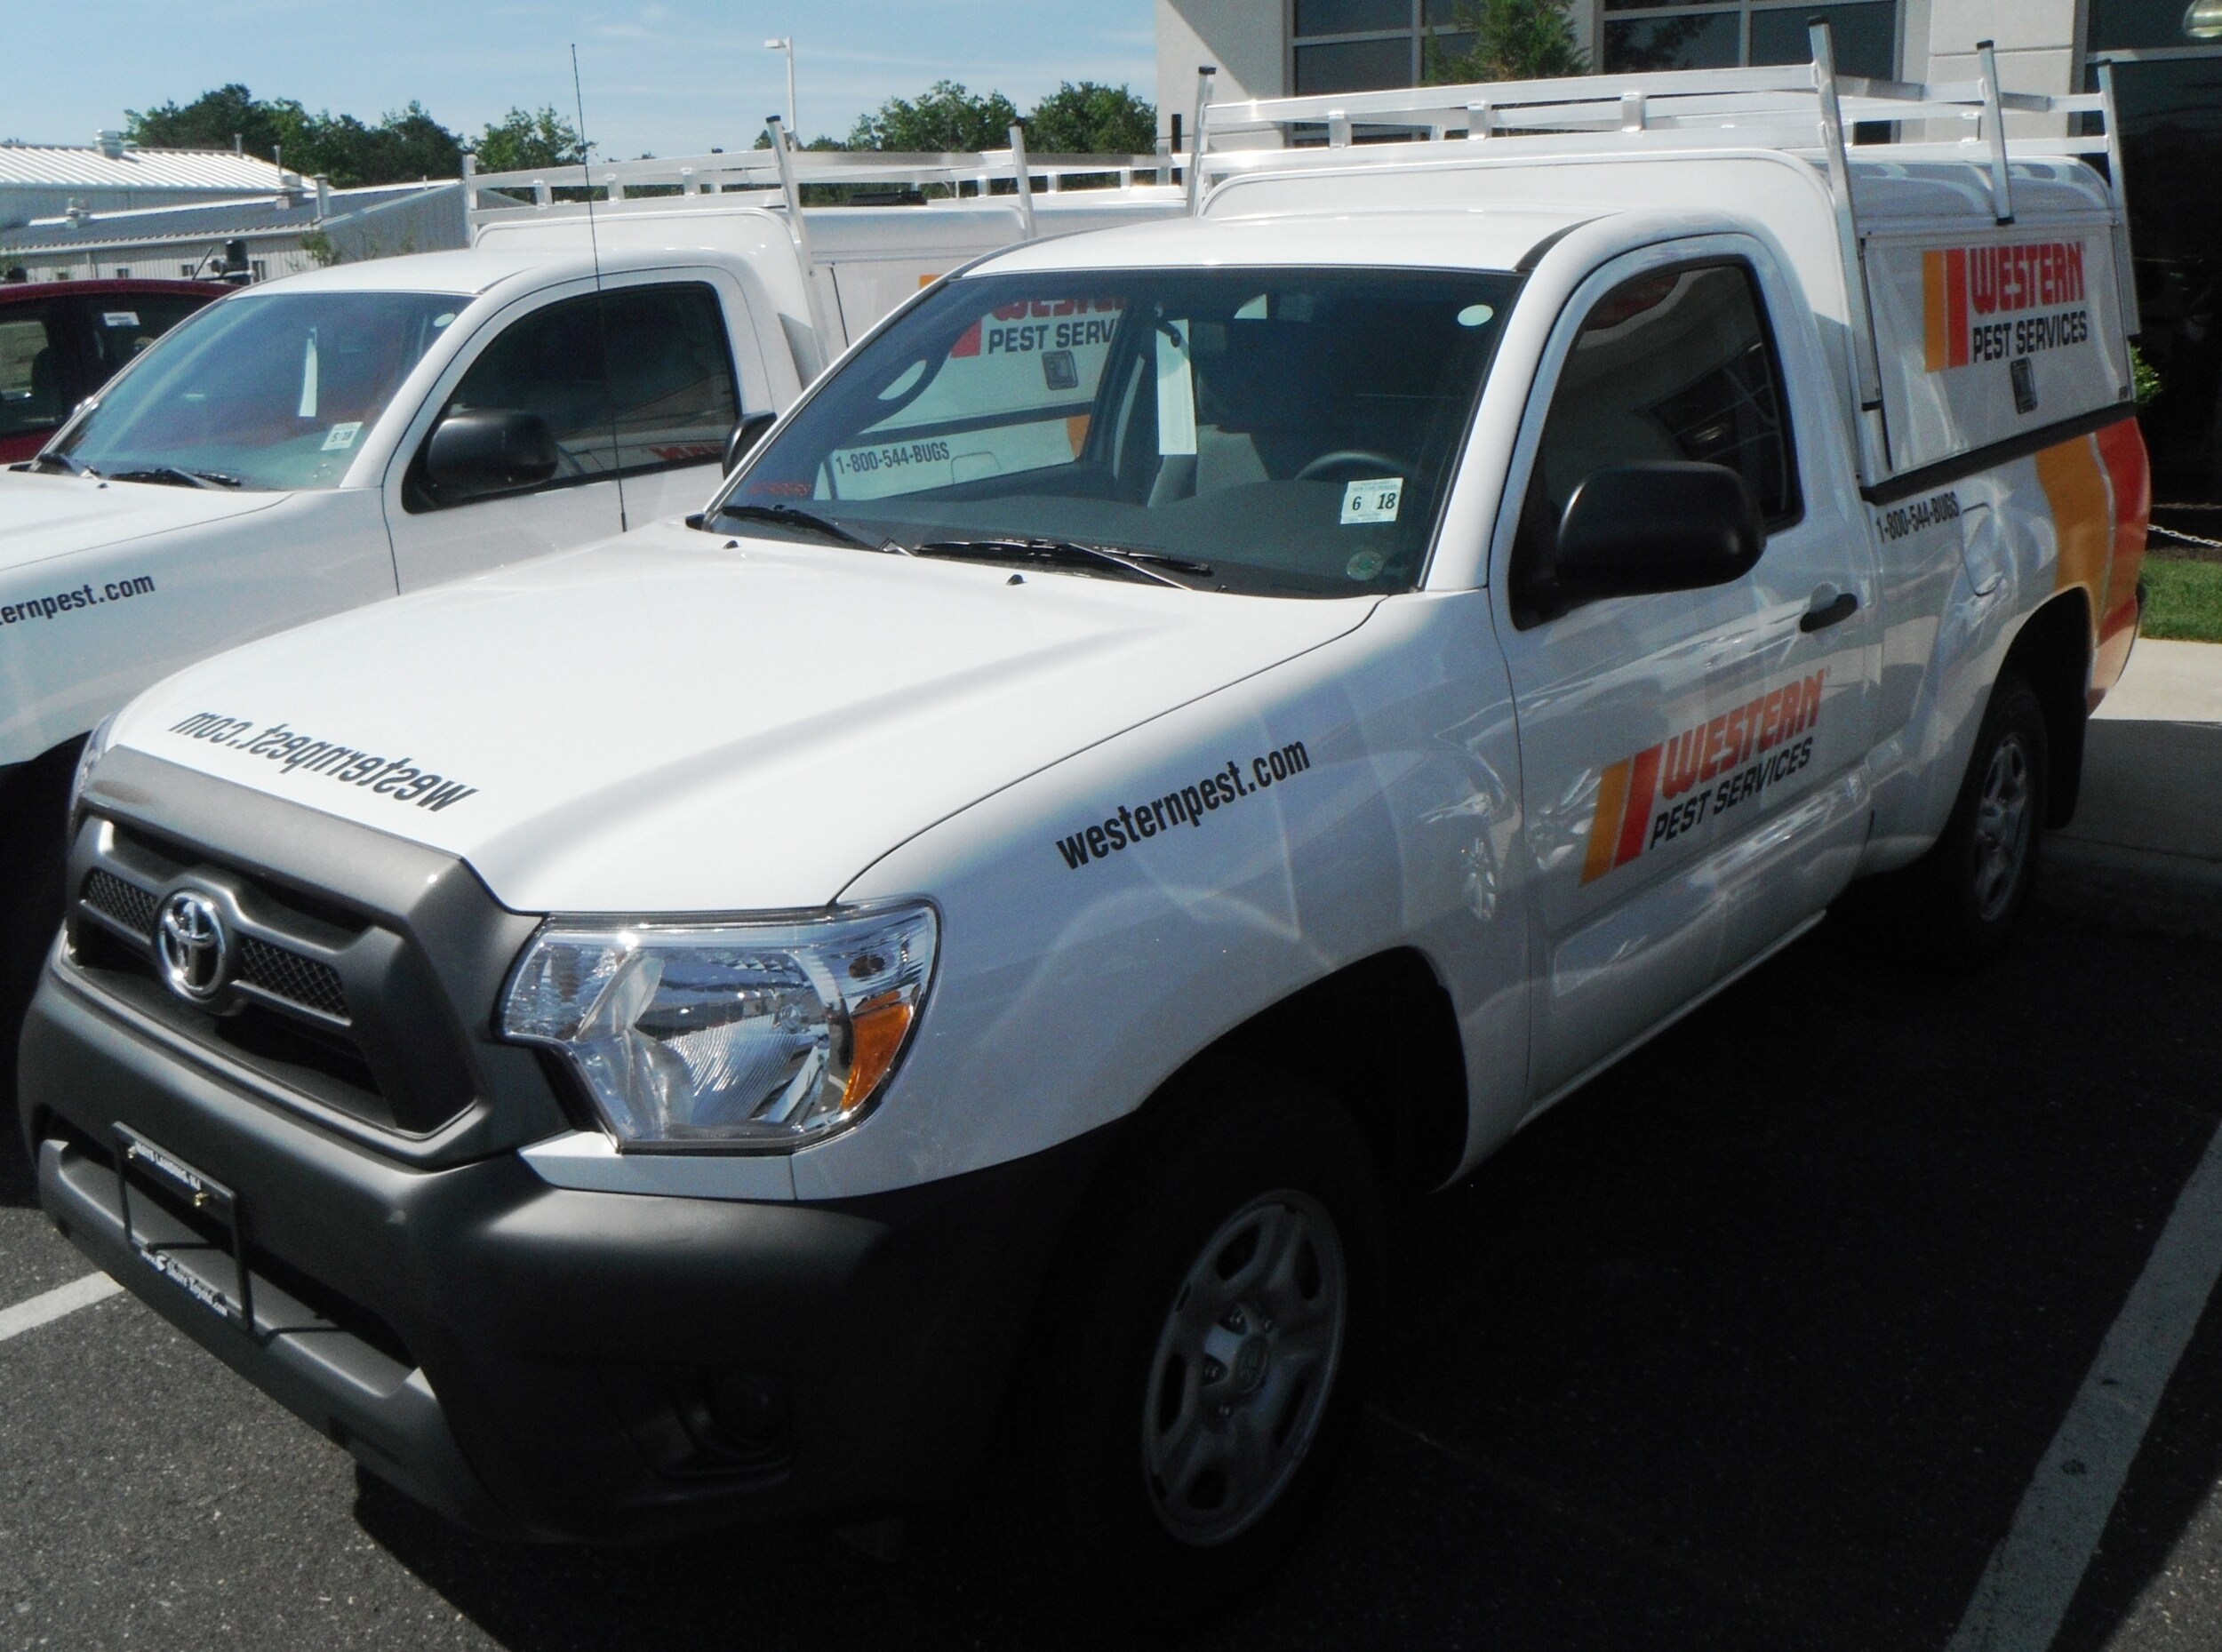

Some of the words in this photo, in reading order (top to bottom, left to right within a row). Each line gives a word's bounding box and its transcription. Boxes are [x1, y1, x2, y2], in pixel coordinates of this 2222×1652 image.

[1970, 242, 2085, 315] WESTERN
[988, 324, 1050, 355] PEST
[1972, 322, 2012, 363] PEST
[2016, 310, 2088, 355] SERVICES
[835, 442, 950, 475] 1-800-544-BUGS
[1352, 496, 1363, 511] 6
[1377, 492, 1396, 510] 18
[1876, 491, 1960, 544] 1-800-544-BUGS
[0, 575, 156, 626] ernpest.com
[1662, 667, 1826, 800] WESTERN
[1056, 740, 1311, 870] westernpest.com
[1649, 789, 1712, 850] PEST
[1714, 736, 1814, 816] SERVICES
